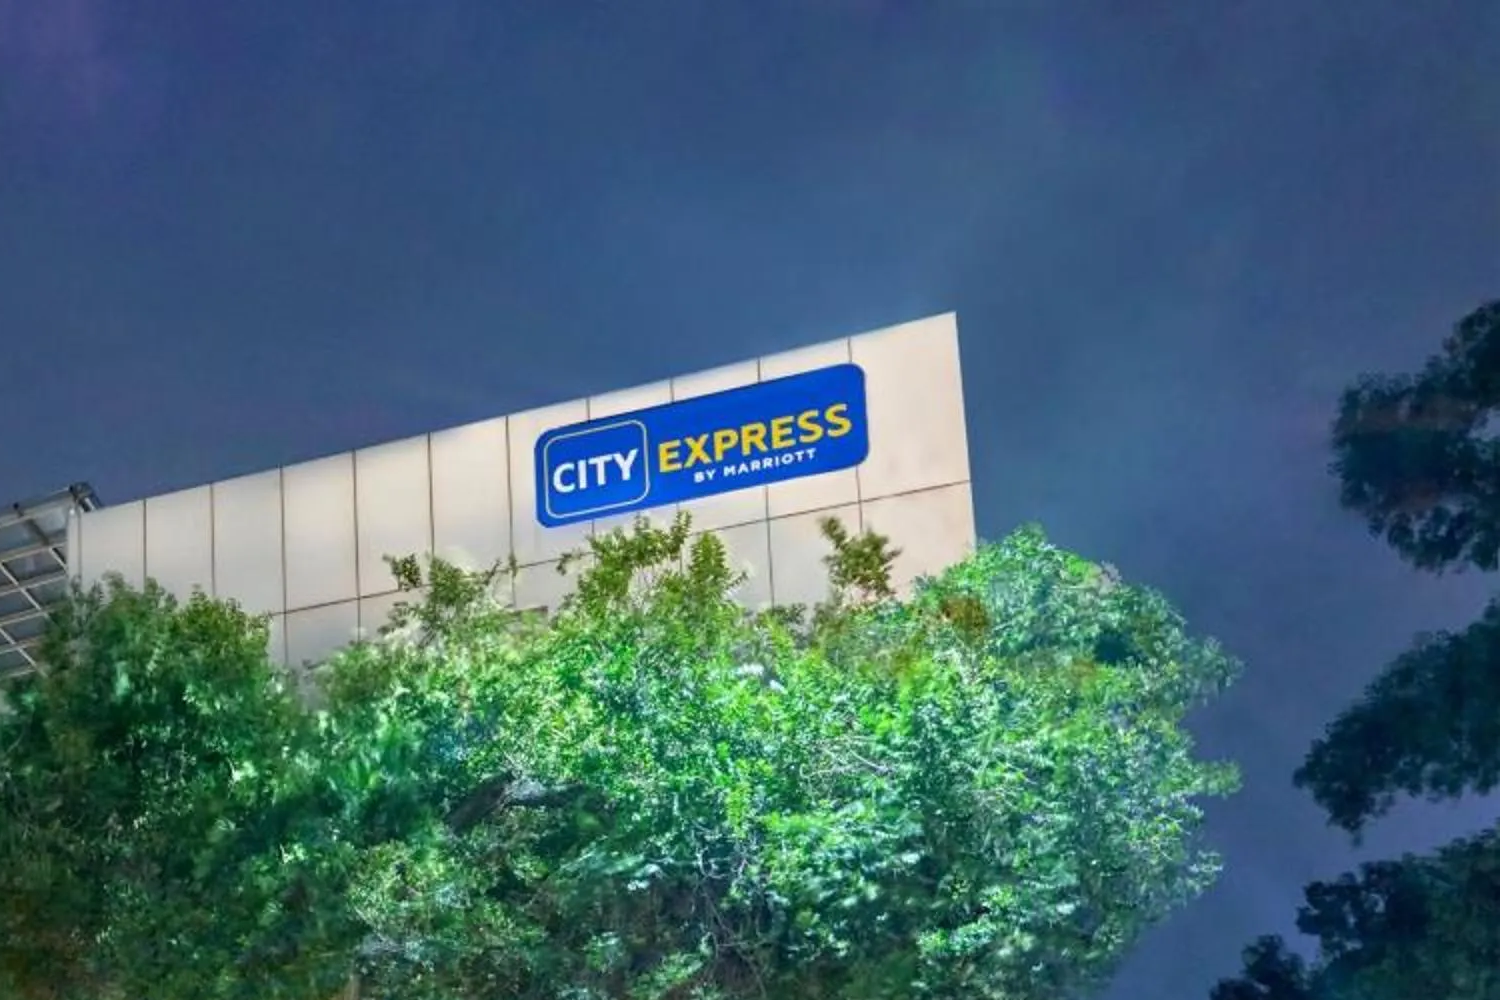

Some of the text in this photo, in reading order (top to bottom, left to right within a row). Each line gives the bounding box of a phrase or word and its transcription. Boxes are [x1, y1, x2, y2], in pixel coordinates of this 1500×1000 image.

[552, 403, 853, 493] CITY EXPRESS
[693, 447, 818, 484] BY MARRIOTT
